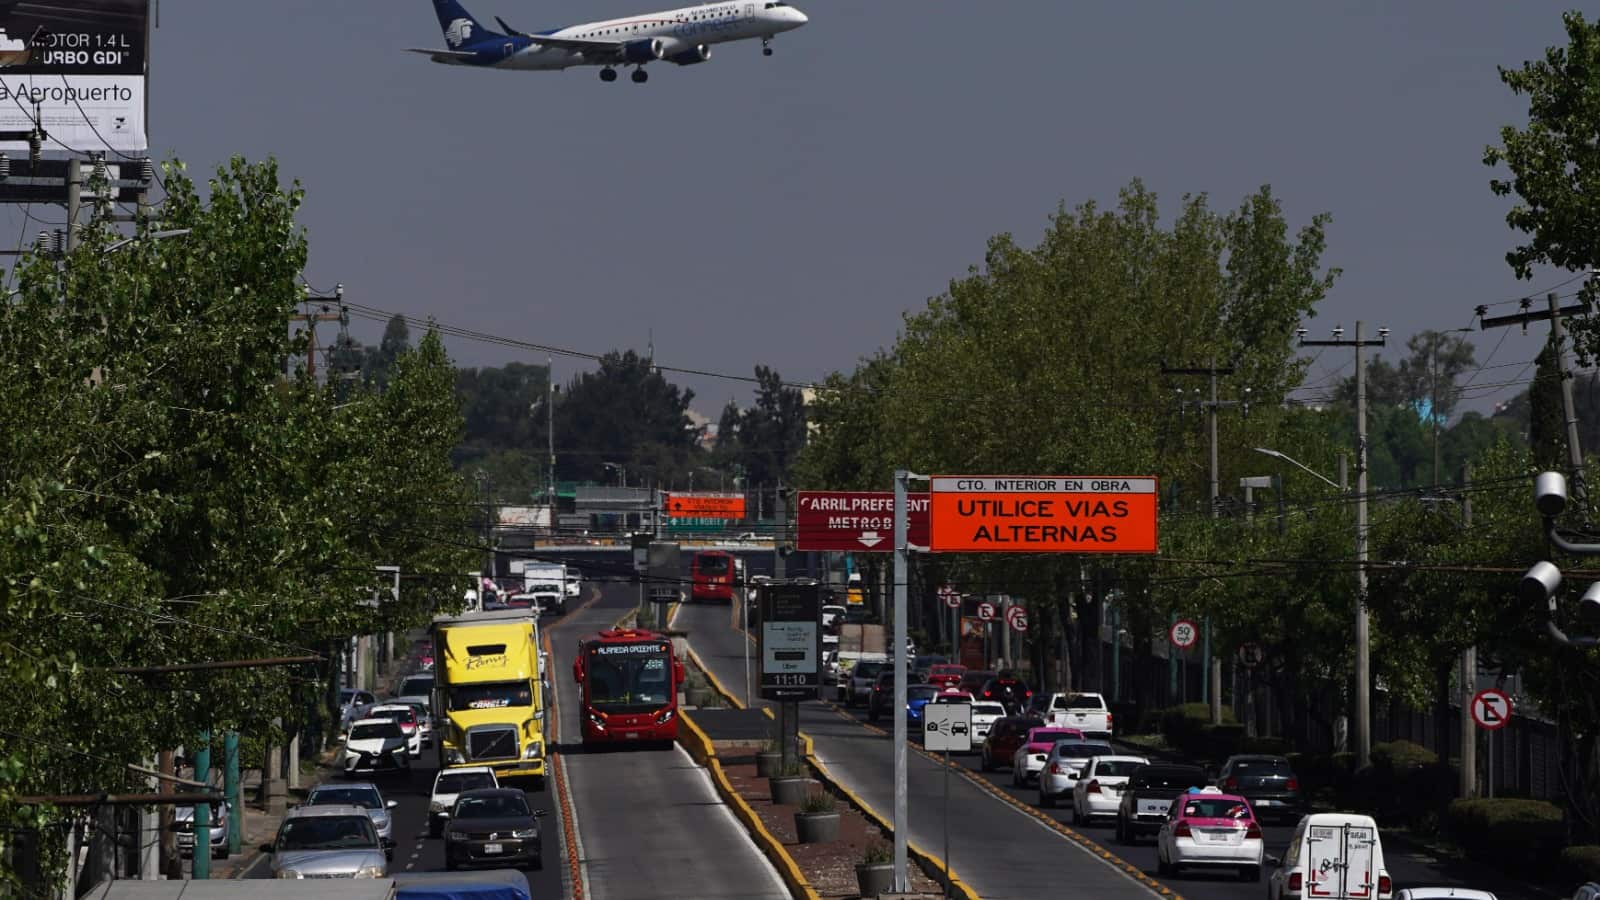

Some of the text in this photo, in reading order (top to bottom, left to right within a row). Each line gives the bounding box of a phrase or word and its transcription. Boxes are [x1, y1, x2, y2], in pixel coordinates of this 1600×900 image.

[95, 34, 116, 48] 1.4
[121, 34, 130, 48] L
[43, 51, 89, 65] URBO
[16, 83, 132, 105] Aeropuerto
[957, 479, 1131, 491] CTO. INTERIOR EN OBRA
[852, 498, 930, 512] PREFEENT
[957, 500, 1129, 518] UTILICE VIAS
[828, 517, 911, 530] METROBS
[972, 525, 1118, 543] ALTERNAS
[1177, 627, 1190, 635] 50
[774, 674, 806, 685] 11:10
